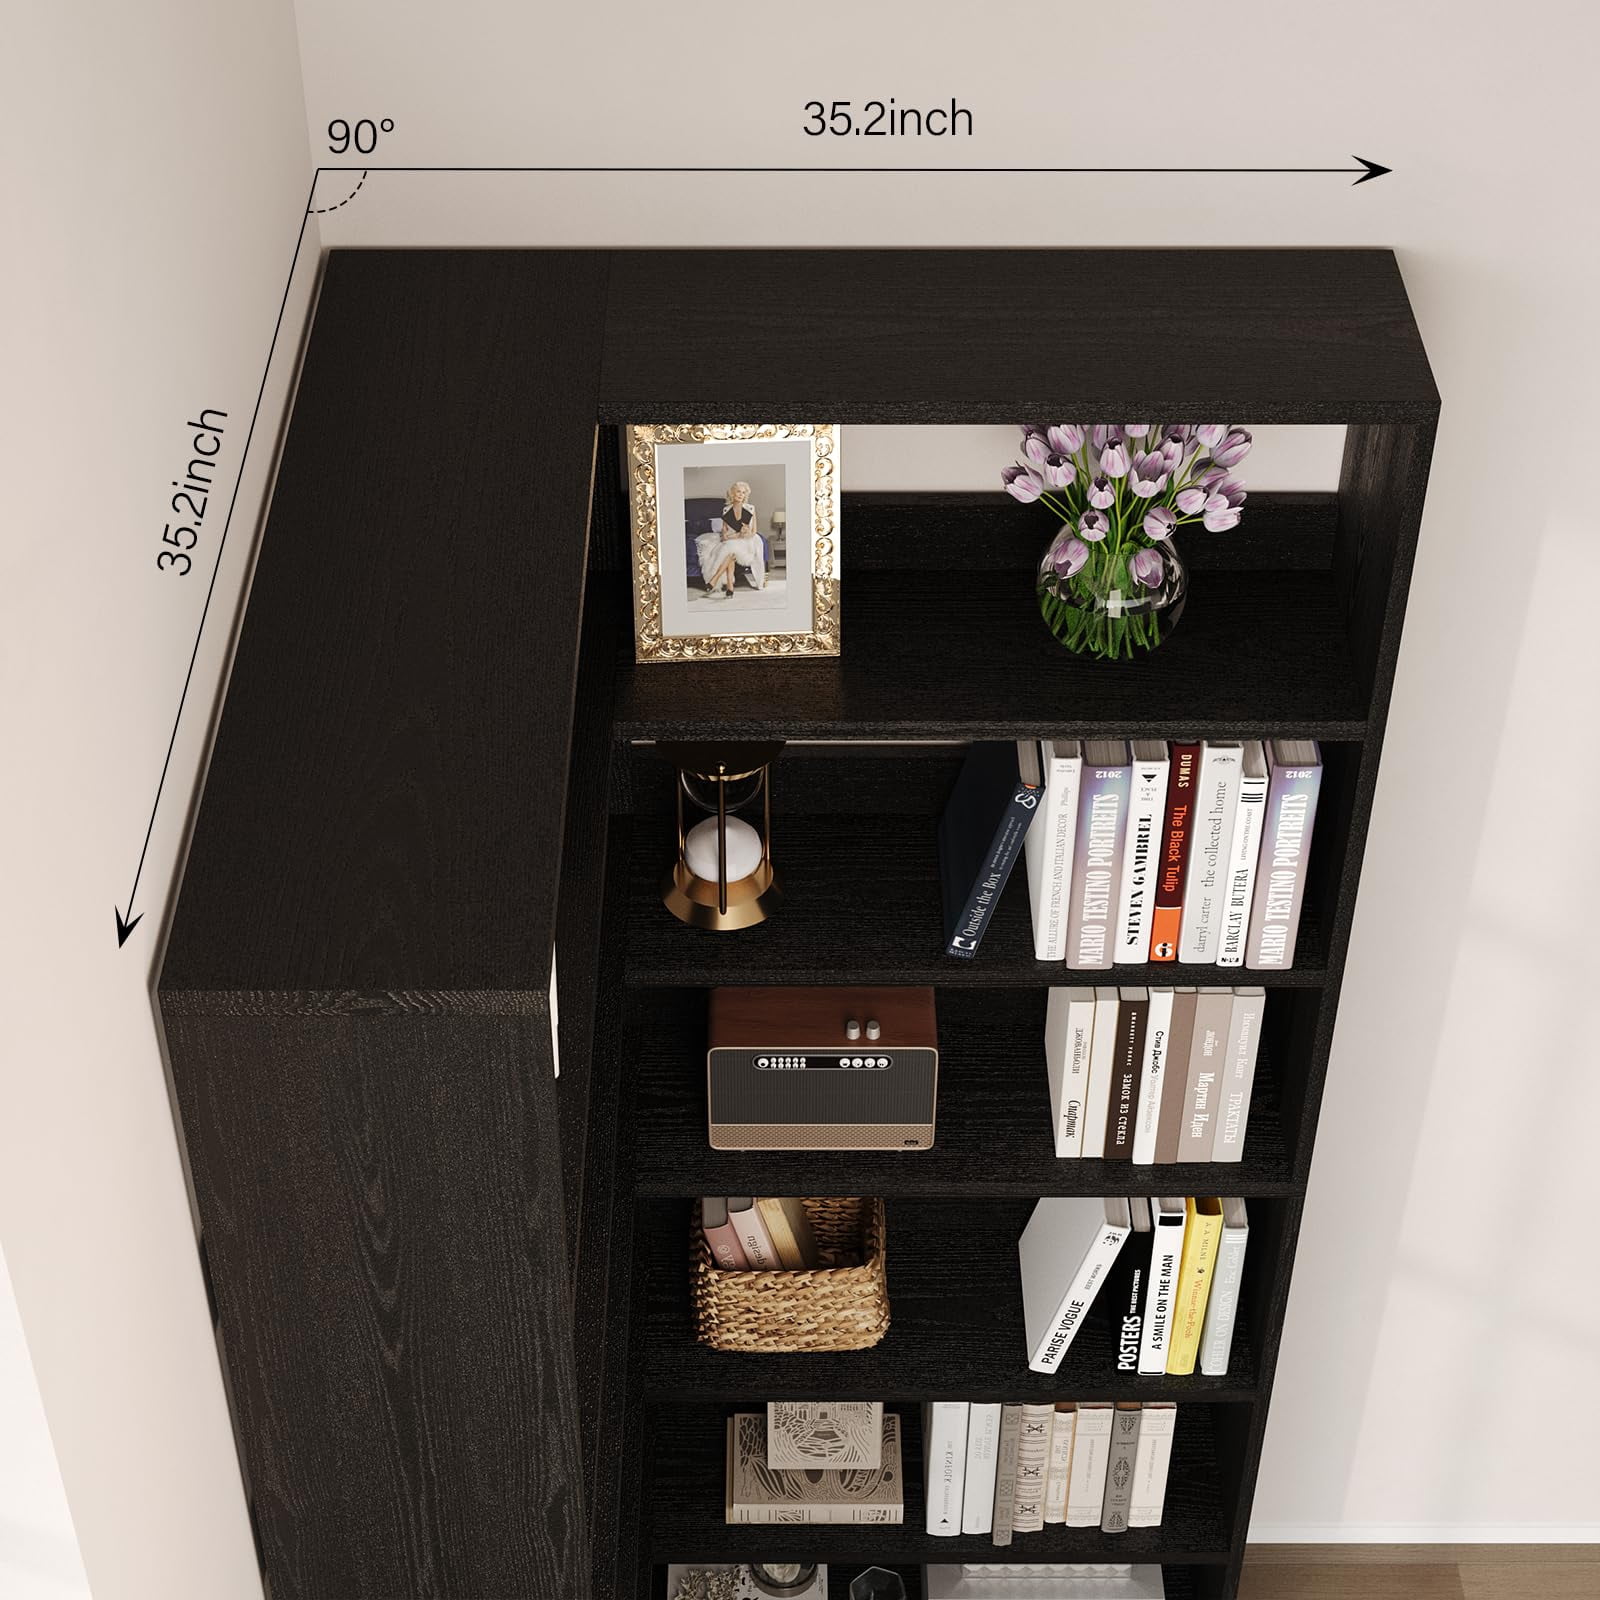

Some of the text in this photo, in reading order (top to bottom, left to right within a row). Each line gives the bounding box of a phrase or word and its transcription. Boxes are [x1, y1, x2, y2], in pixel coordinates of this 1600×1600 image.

[1095, 770, 1122, 779] 2012
[1177, 754, 1193, 788] DUMAS
[1285, 770, 1312, 779] 2012
[1162, 805, 1187, 892] The Black Tulip
[1201, 782, 1226, 887] the collected home
[1046, 814, 1068, 959] THE ALLURE OF FRENCH AND ITALIAN DECOR
[1078, 794, 1119, 965] MARIO TESTINO PORTREITS
[1127, 814, 1152, 945] STEVEN GAMBREL
[1231, 868, 1248, 906] BUTERA
[1258, 794, 1308, 965] MARIO TESTINO PORTREITS
[962, 872, 1001, 937] Outside the Box
[1193, 897, 1211, 952] darryl carter
[1224, 911, 1242, 953] BARCLAY
[1151, 1031, 1164, 1074] Стив Джобс
[1235, 1058, 1248, 1078] Кант
[1065, 1100, 1081, 1138] Спартак
[1191, 1072, 1215, 1138] Мартин Иден
[1224, 1092, 1243, 1143] ТРАКТАТЫ
[1161, 1254, 1174, 1276] MAN
[1199, 1238, 1208, 1260] MILNE
[1156, 1298, 1168, 1313] ON
[1158, 1278, 1170, 1297] THE
[1217, 1290, 1234, 1321] DESIGN
[1041, 1300, 1085, 1365] PARISE VOGUE
[1117, 1315, 1141, 1370] POSTERS
[1129, 1304, 1137, 1314] THE
[1133, 1269, 1141, 1291] PICTURES
[1152, 1314, 1166, 1343] SMILE
[1215, 1323, 1229, 1337] ON
